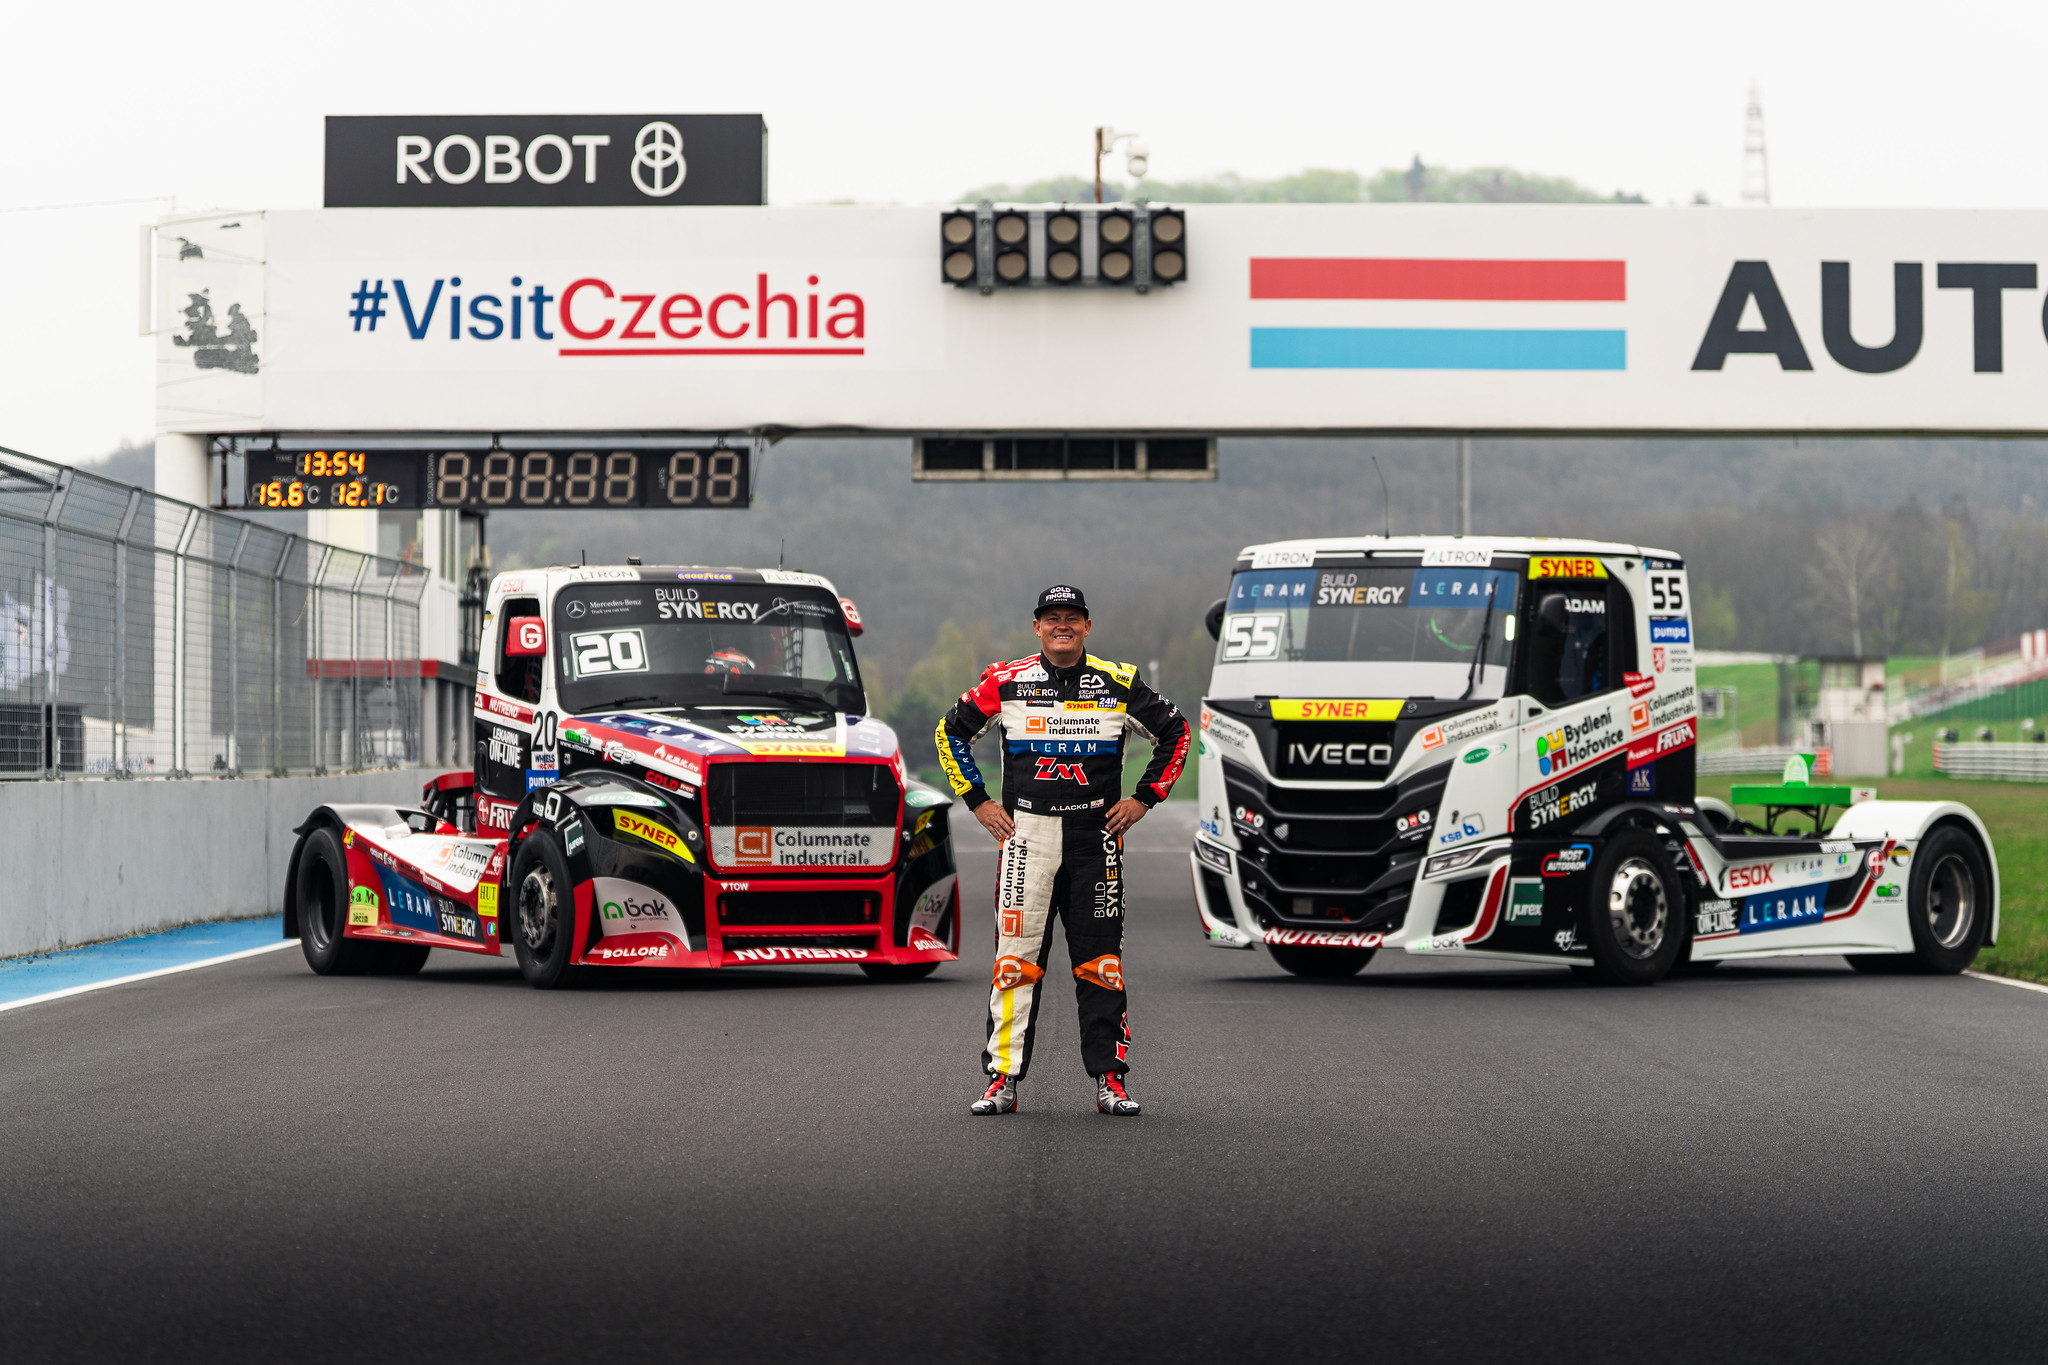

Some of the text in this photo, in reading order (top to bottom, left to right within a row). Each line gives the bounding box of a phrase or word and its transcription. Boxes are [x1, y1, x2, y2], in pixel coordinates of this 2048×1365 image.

[395, 135, 610, 185] ROBOT
[349, 273, 865, 341] #VisitCzechia
[1690, 260, 2048, 374] AUT
[303, 450, 366, 477] 13:54
[1257, 552, 1311, 566] ALTRON
[1427, 551, 1488, 563] ALTRON
[677, 572, 734, 581] GOODYEAR
[1539, 559, 1595, 578] SYNER
[1050, 586, 1071, 594] GOLD
[1321, 574, 1358, 587] BUILD
[654, 588, 698, 600] BUILD
[1045, 592, 1076, 602] FINGERS
[1237, 583, 1307, 598] LERAM
[1317, 586, 1405, 605] SYNERGY
[1651, 576, 1683, 610] 55
[589, 598, 642, 609] Mercedes-Benz
[657, 601, 759, 620] SYNERGY
[1227, 617, 1280, 657] 55
[576, 631, 644, 675] 20
[1016, 689, 1059, 698] SYNERGY
[1099, 697, 1118, 705] 24H
[1648, 686, 1695, 712] Columnate
[489, 698, 520, 718] NUTREND
[1301, 702, 1368, 718] SYNER
[531, 710, 559, 752] 20
[1046, 717, 1100, 726] Columnate
[1442, 709, 1499, 734] Columnate
[1563, 705, 1612, 744] Bydlení
[1030, 742, 1097, 753] LERAM
[1567, 729, 1624, 765] Hořovice
[1656, 722, 1695, 754] FRUM
[754, 744, 835, 753] SYNER
[1288, 744, 1392, 766] IVECO
[645, 770, 679, 792] GOLD
[1529, 785, 1560, 810] BUILD
[1530, 782, 1598, 830] SYNERGY
[1050, 803, 1089, 812] A.LACKO
[619, 815, 678, 849] SYNER
[774, 830, 871, 848] Columnate
[1440, 831, 1463, 845] KSB
[1559, 850, 1584, 861] MOST
[1003, 839, 1016, 908] Columnate
[1100, 829, 1119, 918] SYNERGY
[1547, 861, 1587, 872] AUTODROM
[1729, 862, 1775, 890] ESOX
[480, 884, 497, 902] HUT
[729, 882, 749, 891] TOW
[388, 887, 433, 918] LERAM
[439, 898, 456, 914] BUILD
[1094, 881, 1106, 918] BUILD
[1511, 903, 1543, 922] jurex
[1749, 895, 1818, 925] LERAM
[442, 913, 477, 938] SYNERGY
[1263, 926, 1384, 947] NUTREND
[733, 947, 869, 962] NUTREND
